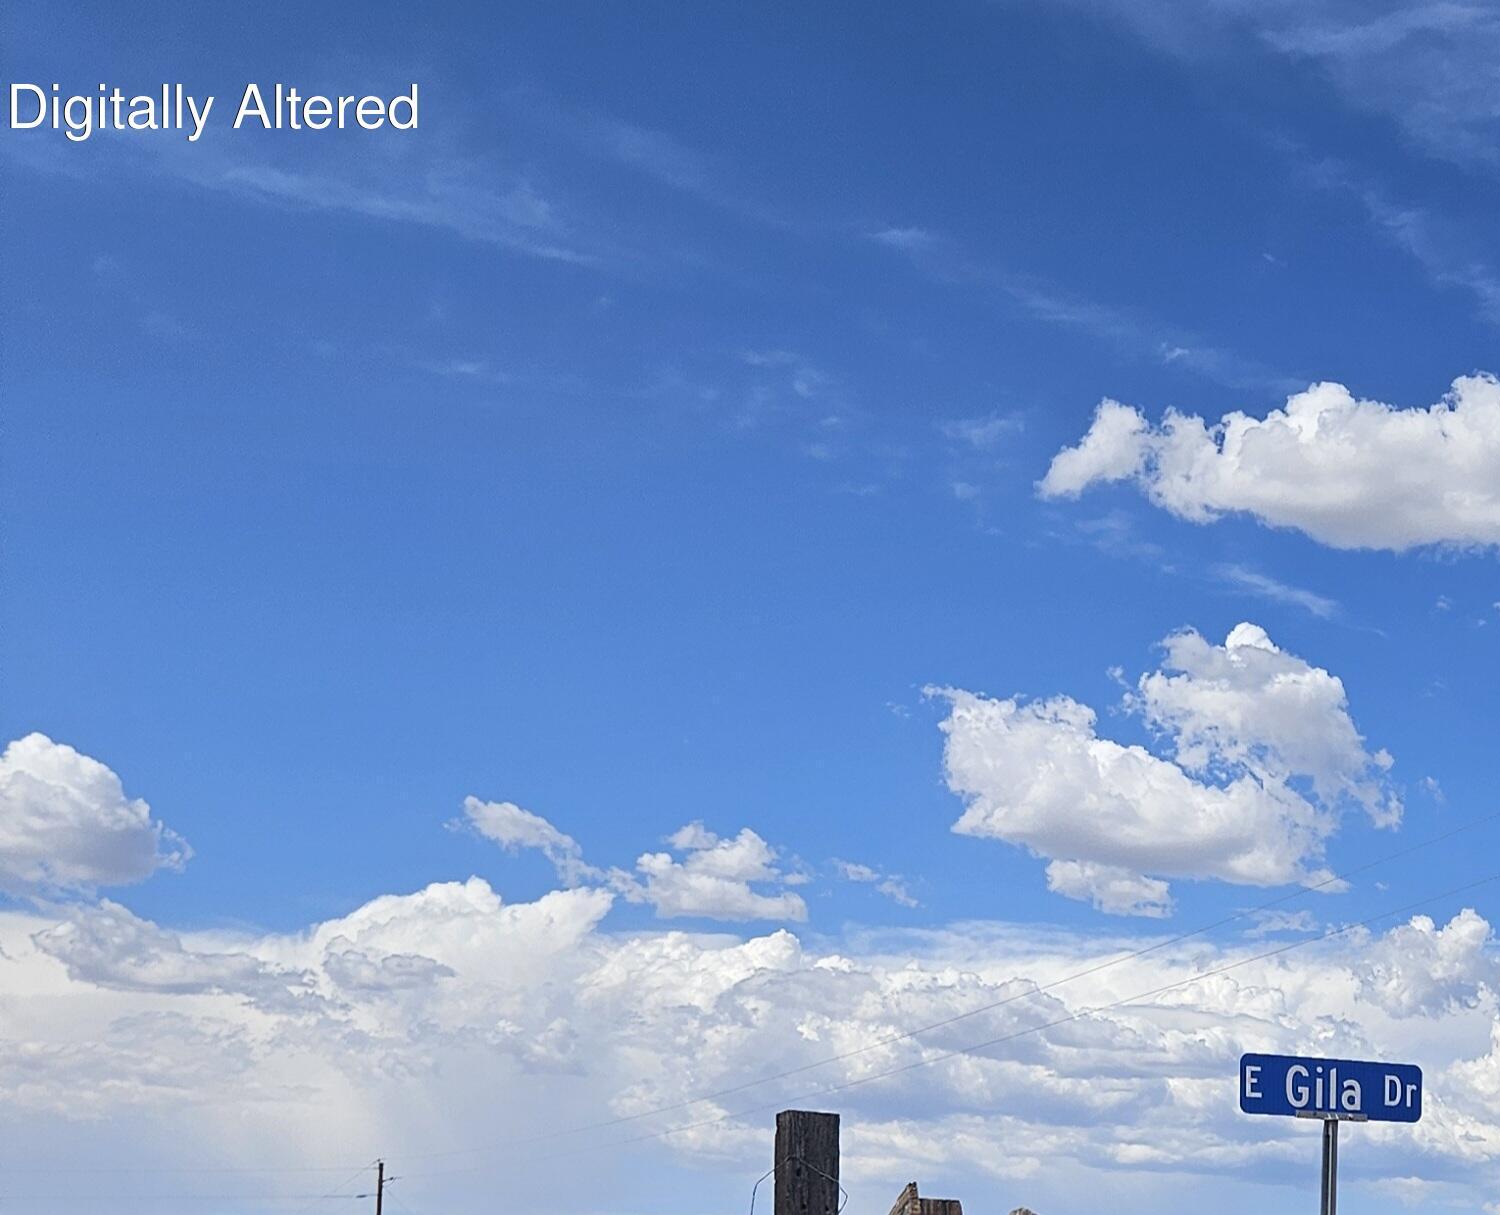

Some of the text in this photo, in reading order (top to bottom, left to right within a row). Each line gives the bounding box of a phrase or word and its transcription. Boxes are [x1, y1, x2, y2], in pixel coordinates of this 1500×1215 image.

[1245, 1064, 1417, 1111] E Gila Dr
